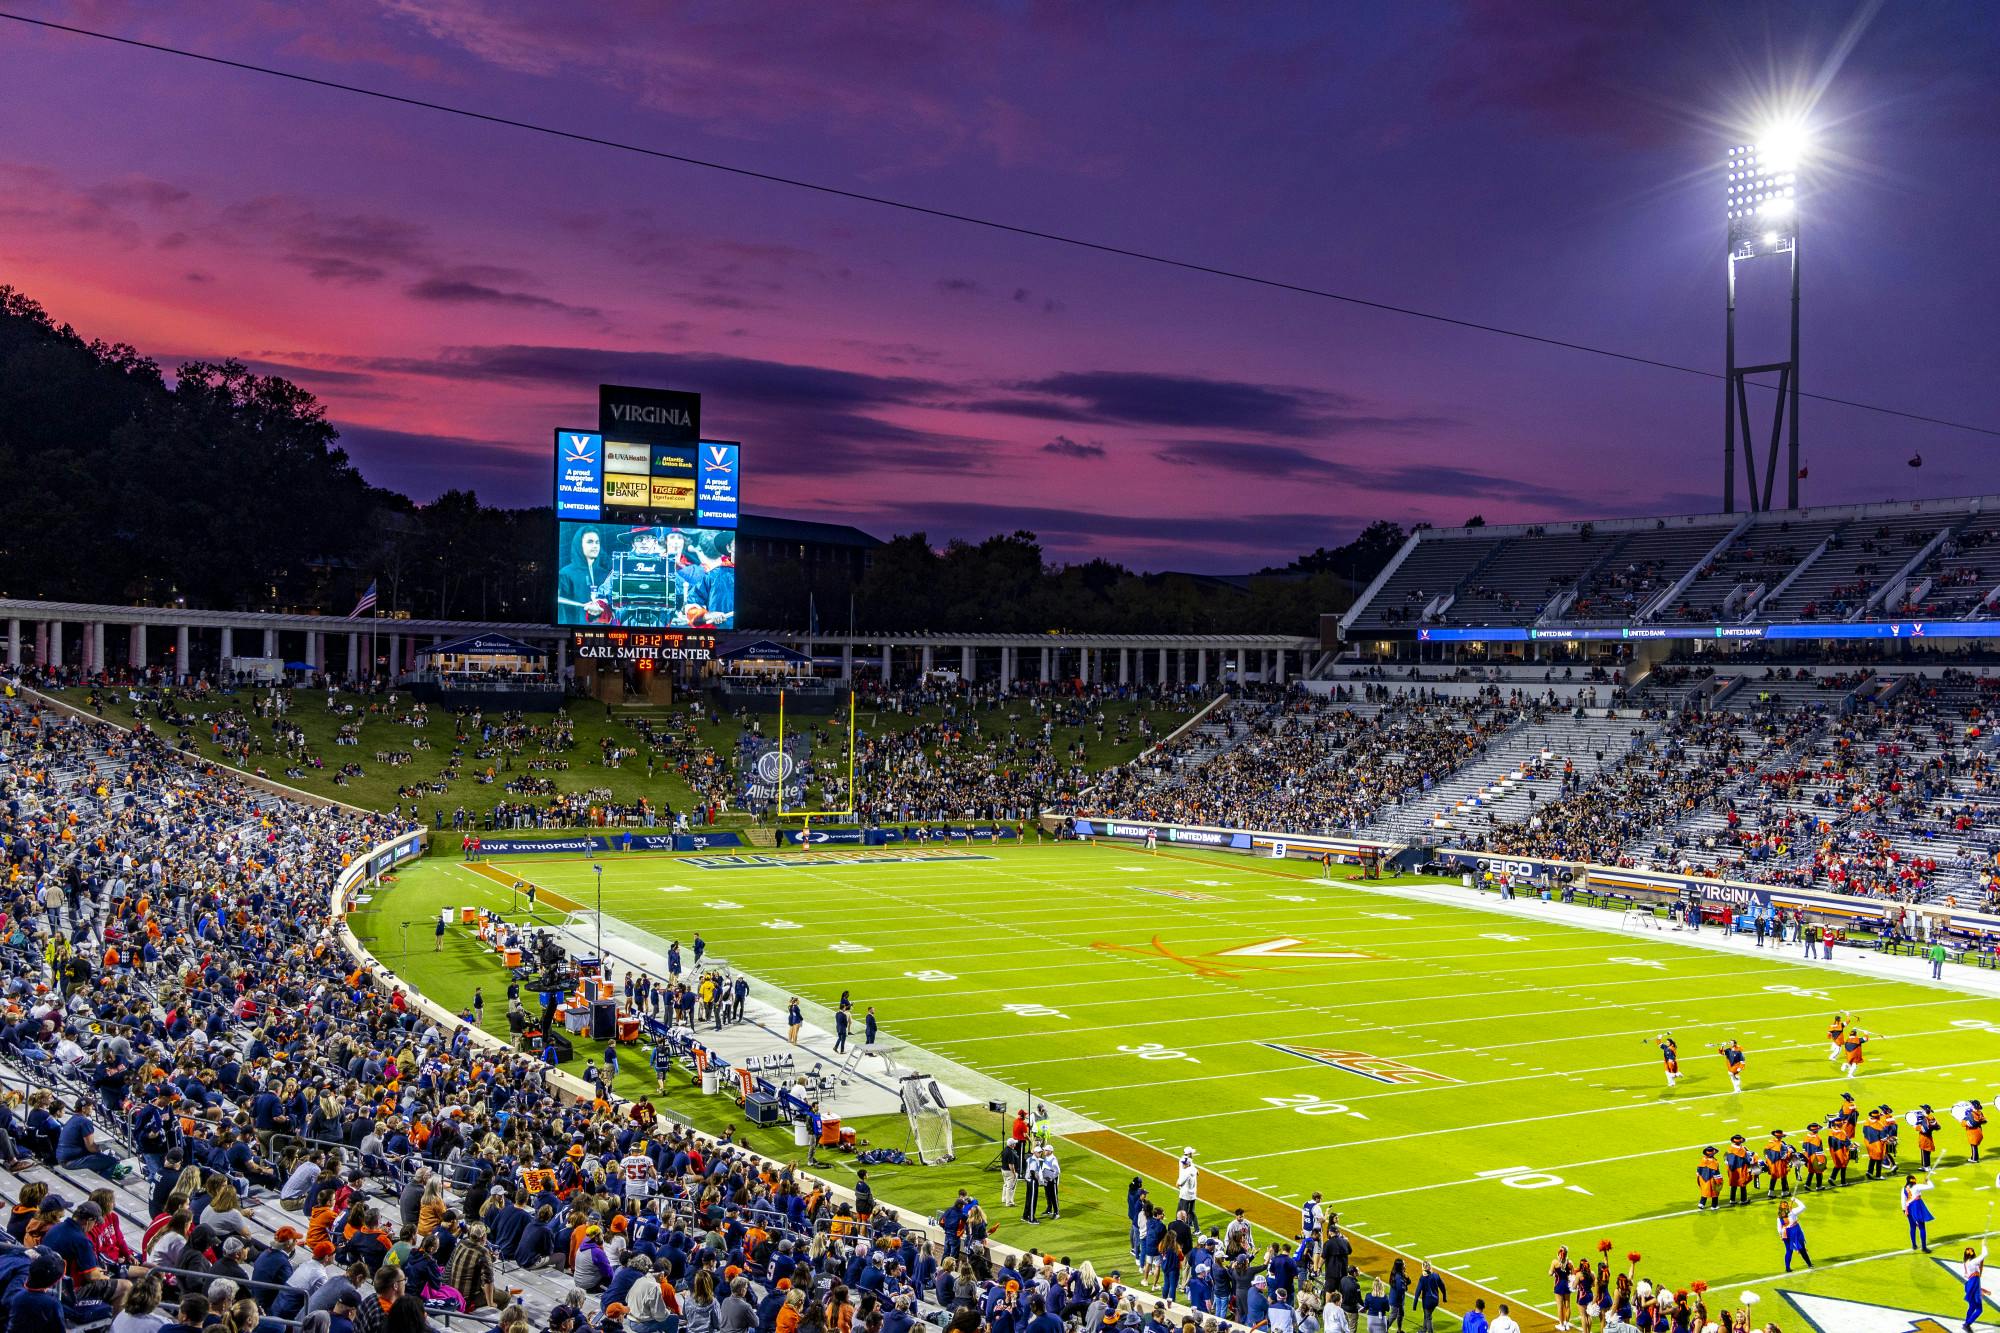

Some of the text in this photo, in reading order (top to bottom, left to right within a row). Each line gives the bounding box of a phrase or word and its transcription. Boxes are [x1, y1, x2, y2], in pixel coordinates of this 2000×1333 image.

[610, 404, 692, 427] VIRGINIA
[573, 485, 599, 493] Athletics
[616, 482, 648, 490] UNITED
[576, 637, 582, 645] 3
[635, 634, 661, 646] 13:12
[673, 639, 679, 647] 0
[709, 640, 714, 648] 3
[580, 646, 711, 660] CARL SMITH CENTER
[640, 659, 652, 669] 25
[1113, 826, 1138, 836] UNITED
[1176, 830, 1222, 843] UNITED BANK
[1695, 883, 1761, 905] VIRGINIA
[1117, 1042, 1164, 1061] 30
[1276, 1043, 1468, 1085] ACC
[1261, 1094, 1350, 1116] 20
[627, 1164, 648, 1180] 55
[1473, 1165, 1566, 1190] 10
[633, 1223, 645, 1239] 14
[767, 1261, 776, 1280] 9
